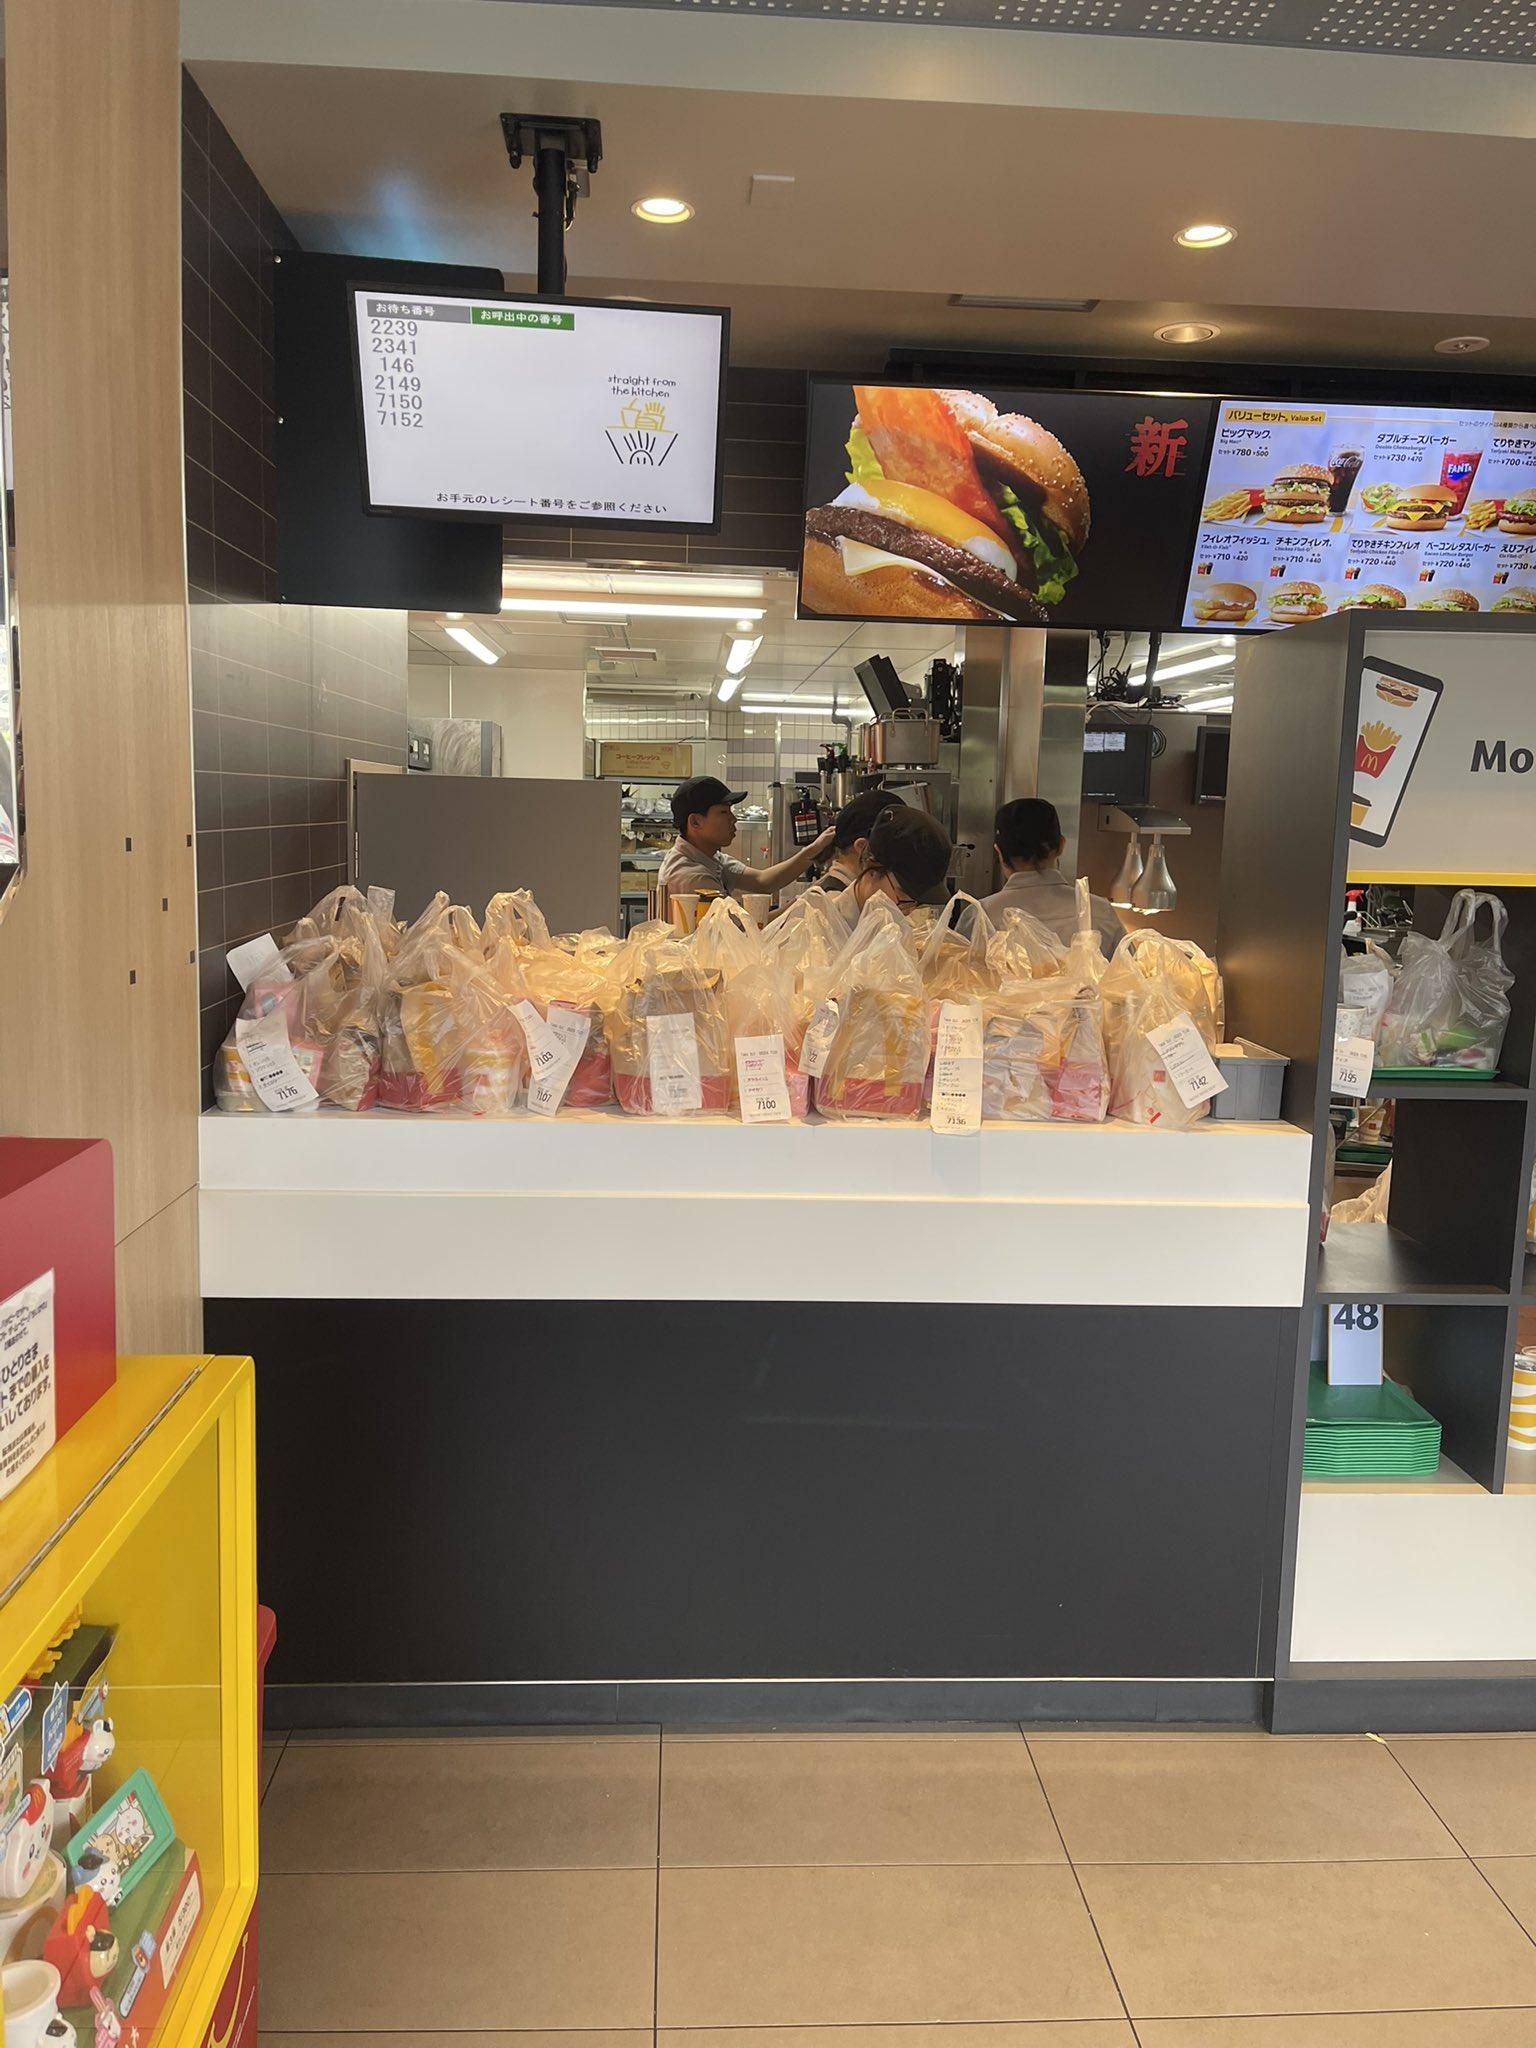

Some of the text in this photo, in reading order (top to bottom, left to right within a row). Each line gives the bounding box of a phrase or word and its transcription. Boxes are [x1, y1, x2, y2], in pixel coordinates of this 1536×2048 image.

[375, 303, 436, 316] お待ち番号
[480, 310, 563, 325] お呼出中の番号
[370, 318, 418, 336] 2239
[372, 337, 417, 355] 2341
[380, 357, 414, 373] 146
[375, 375, 421, 392] 2149
[608, 374, 677, 387] straight from
[612, 386, 670, 398] the kitchen
[376, 393, 422, 410] 7150
[378, 411, 423, 428] 7152
[1124, 415, 1189, 478] 新
[1376, 433, 1457, 445] ダブルチーズバーガー
[1447, 463, 1472, 473] FANTA
[436, 491, 668, 514] お手元のレシート番号をご参照ください
[1470, 740, 1534, 773] Mo
[535, 1051, 553, 1067] 7103
[1190, 1075, 1208, 1091] 7142
[1339, 1071, 1357, 1083] 7195
[277, 1086, 298, 1100] 7176
[757, 1100, 776, 1110] 7100
[1333, 1303, 1379, 1331] 48
